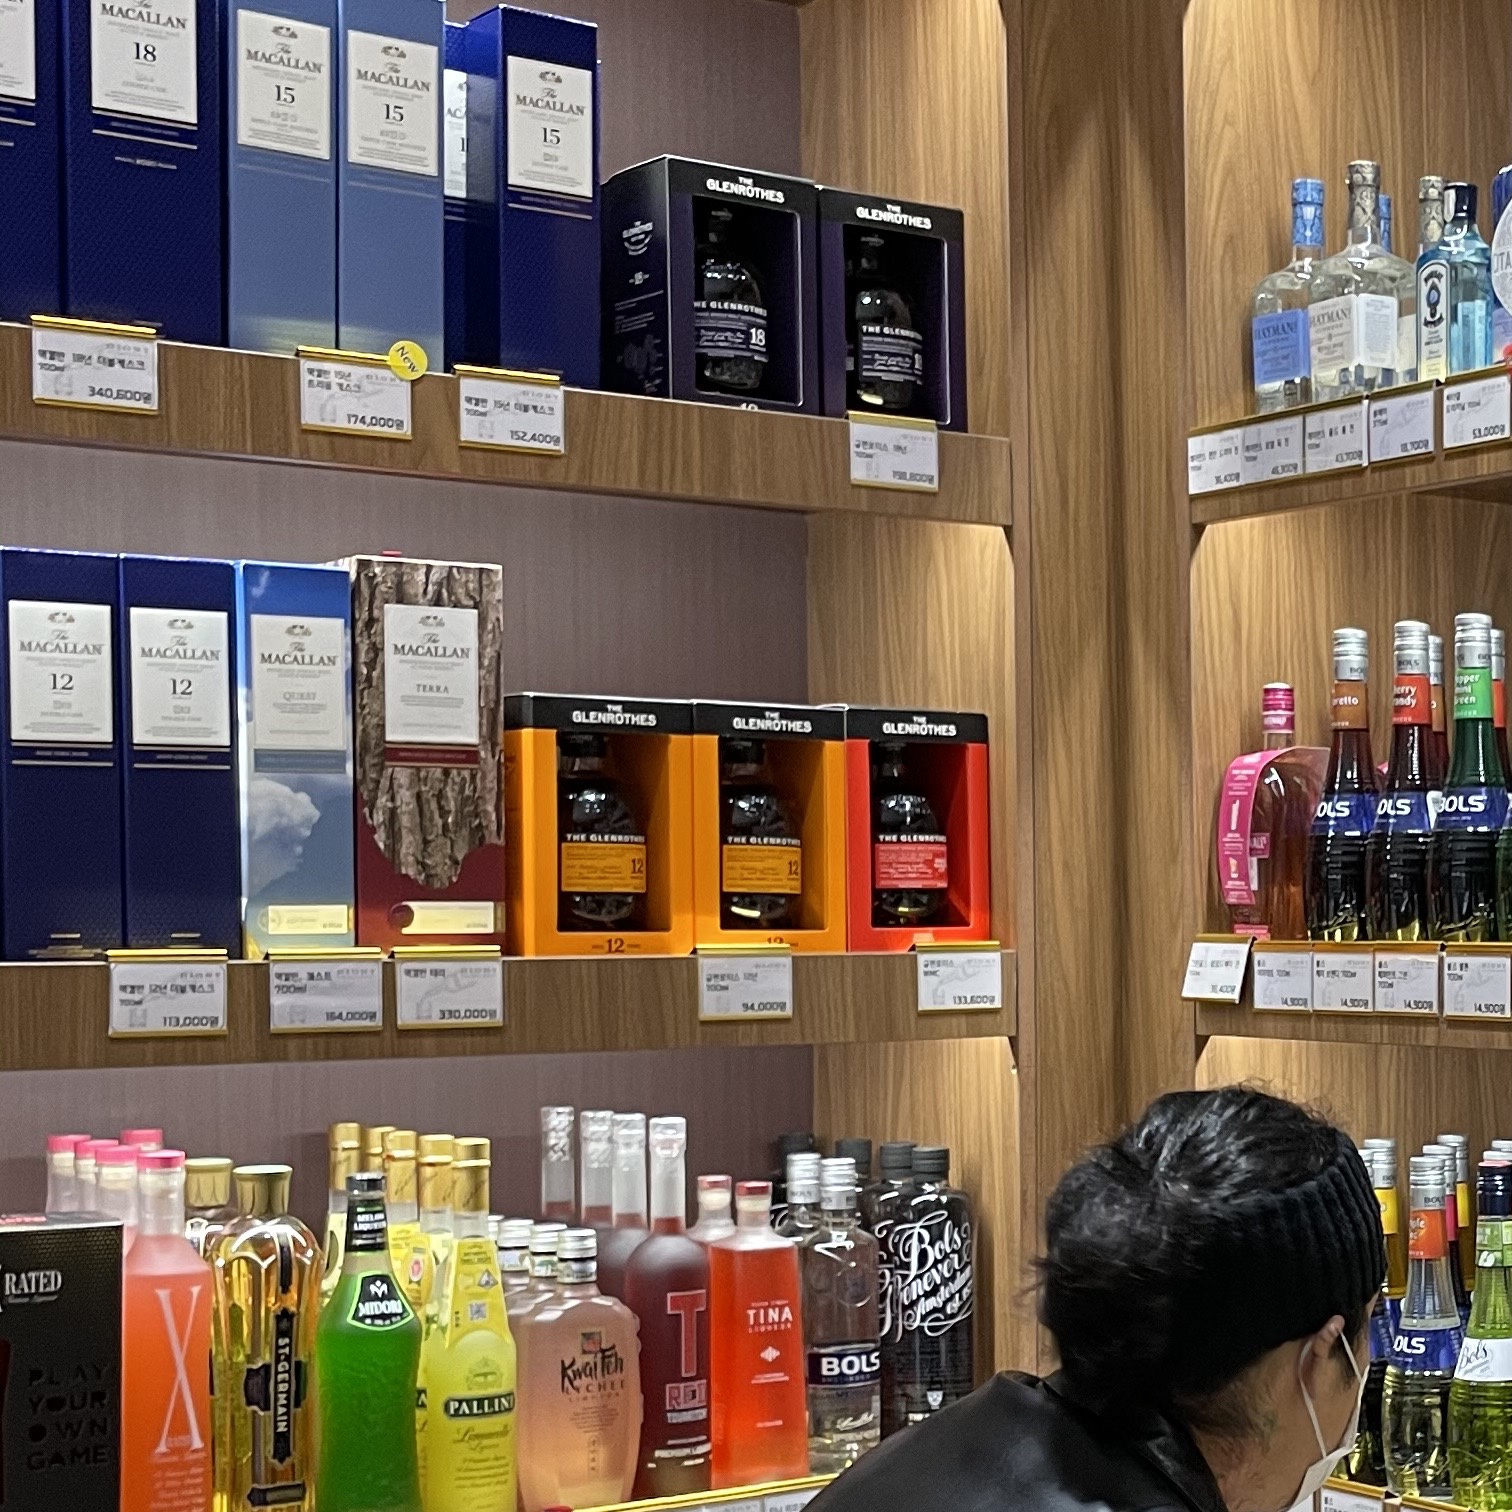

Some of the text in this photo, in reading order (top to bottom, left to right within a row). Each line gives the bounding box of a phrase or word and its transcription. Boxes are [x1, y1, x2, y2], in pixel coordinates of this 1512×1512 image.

[100, 5, 188, 30] MACALLAN
[132, 41, 158, 63] 18
[245, 47, 324, 76] MACALLAN
[355, 67, 431, 93] MACALLAN
[273, 84, 296, 106] 15
[383, 103, 405, 124] 15
[514, 93, 586, 117] MACALLAN
[541, 126, 562, 147] 15
[705, 179, 786, 203] GLENROTHES
[855, 207, 932, 230] GLENROTHES
[749, 327, 767, 347] 18
[396, 345, 419, 374] New
[346, 413, 405, 431] 174,000원
[19, 641, 105, 656] MACALLAN
[140, 646, 221, 662] MACALLAN
[392, 644, 470, 659] MACALLAN
[259, 653, 338, 667] MACALLAN
[49, 673, 75, 692] 12
[169, 678, 194, 697] 12
[415, 683, 450, 695] TERRA
[572, 710, 657, 727] GLENROTHES
[606, 705, 623, 714] THE
[732, 716, 813, 734] GLENROTHES
[882, 720, 957, 738] GLENROTHES
[630, 858, 645, 876] 12
[786, 859, 799, 877] 12
[605, 936, 626, 954] 12
[4, 1270, 62, 1296] RATED
[357, 1298, 403, 1318] MIDORI
[746, 1306, 793, 1324] TINA
[821, 1353, 881, 1377] BOLS
